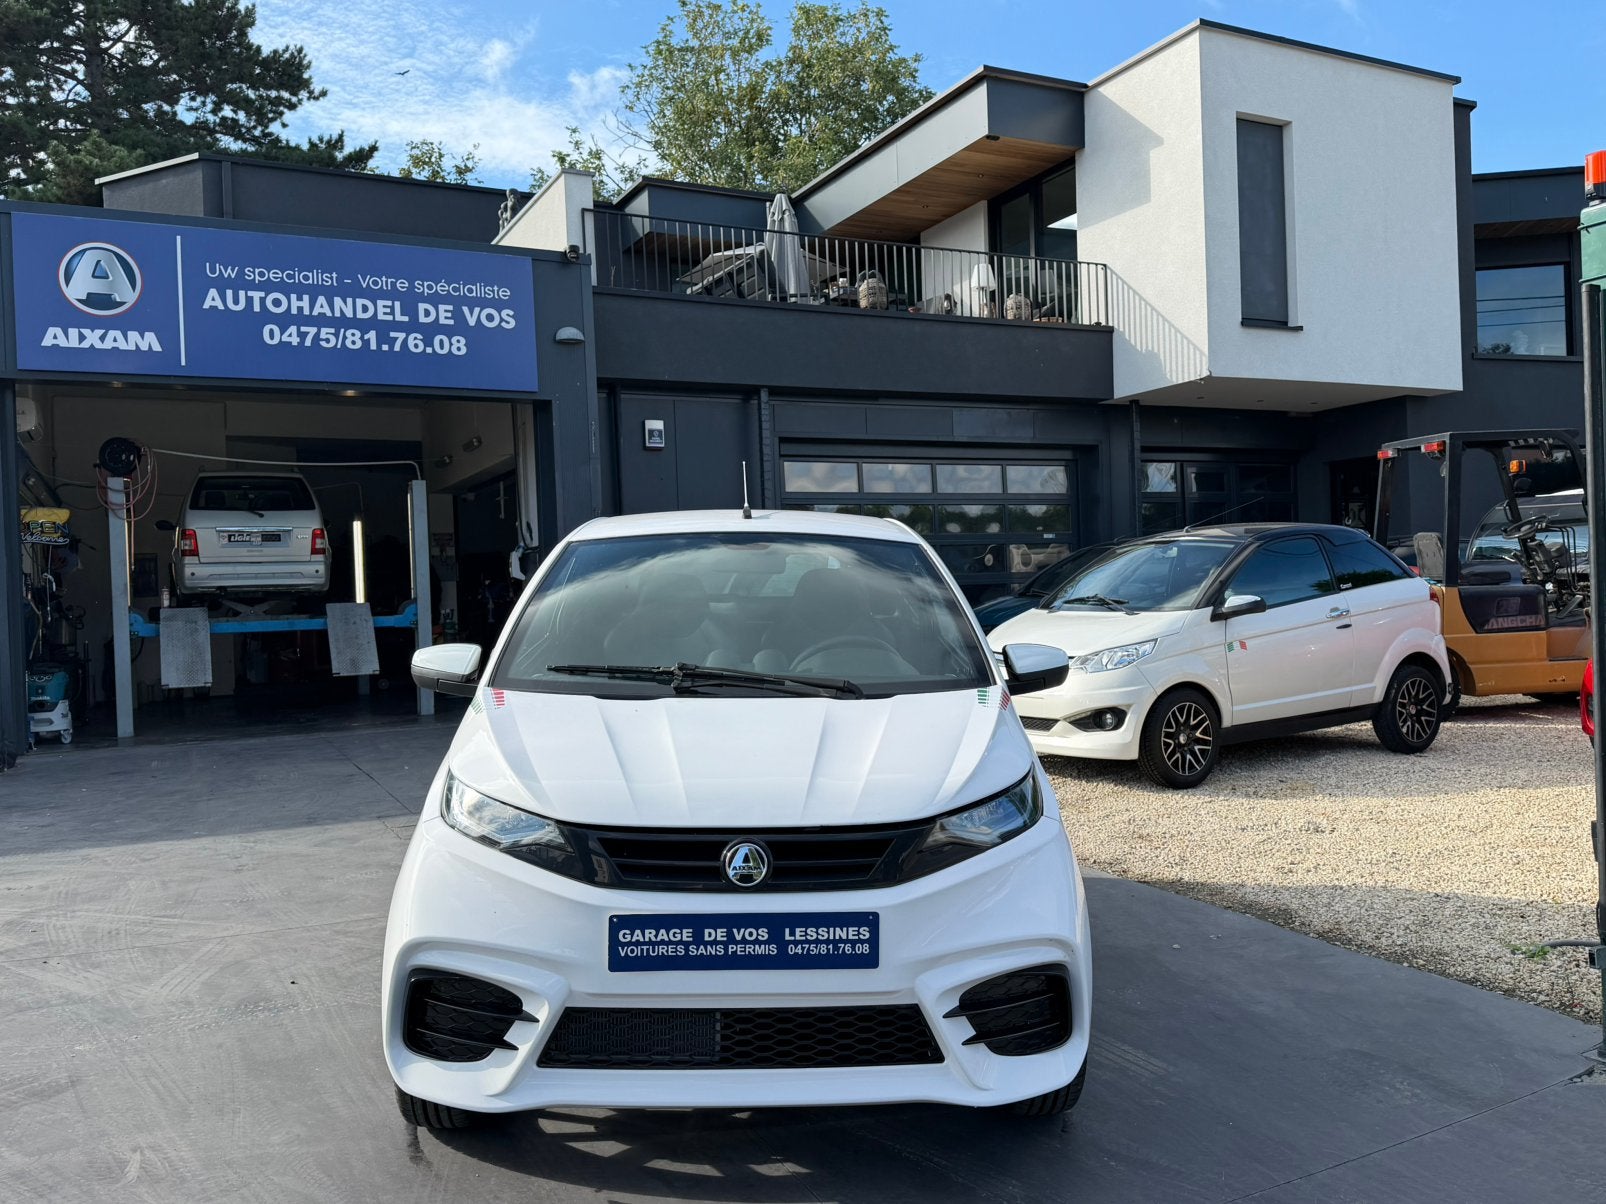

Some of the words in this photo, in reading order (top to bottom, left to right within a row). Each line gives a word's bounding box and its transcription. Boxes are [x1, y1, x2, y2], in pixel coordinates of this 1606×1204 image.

[206, 262, 238, 279] Uw
[244, 267, 338, 286] specialist
[357, 274, 409, 291] Votre
[414, 279, 511, 300] spécialiste
[202, 288, 409, 322] AUTOHANDEL
[418, 302, 455, 325] DE
[462, 306, 516, 329] VOS
[41, 326, 162, 352] AIXAM
[262, 324, 467, 355] 0475/81.76.08
[618, 928, 693, 942] GARAGE
[704, 928, 727, 941] DE
[733, 928, 769, 941] VOS
[784, 927, 870, 940] LESSINES
[618, 945, 685, 957] VOITURES
[688, 944, 725, 956] SANS
[728, 944, 778, 956] PERMIS
[788, 943, 870, 955] 0475/81.76.08
